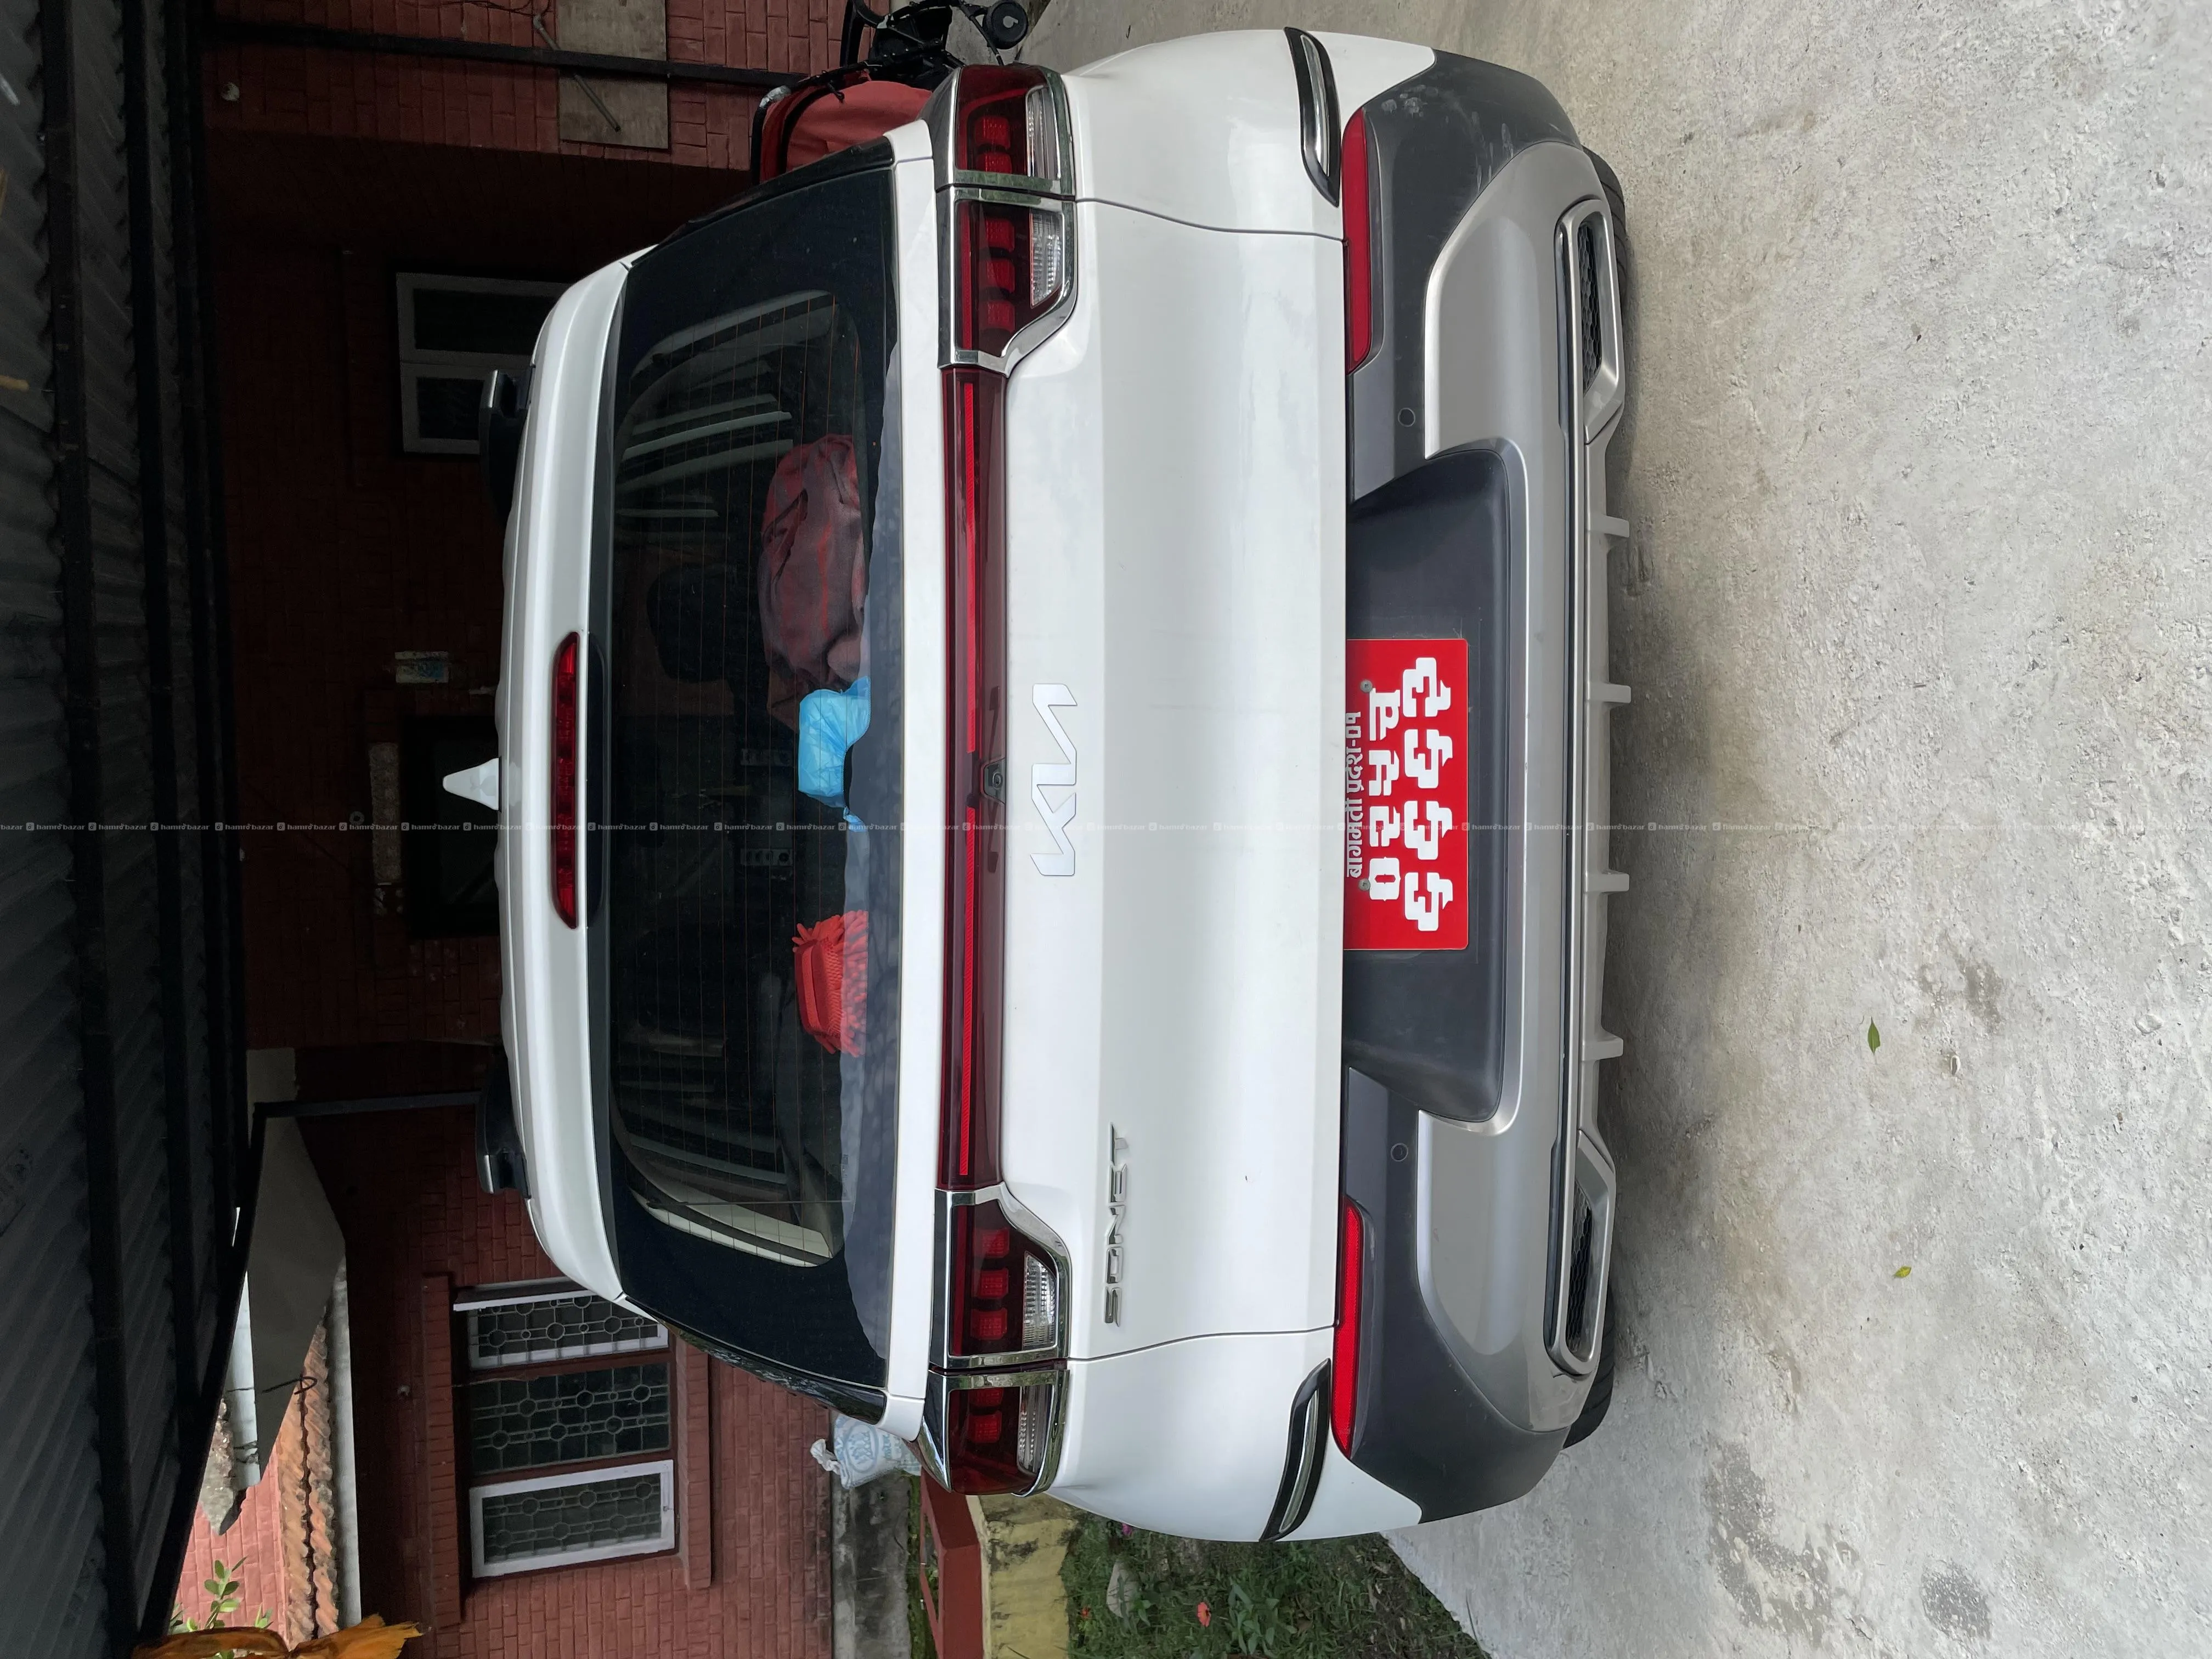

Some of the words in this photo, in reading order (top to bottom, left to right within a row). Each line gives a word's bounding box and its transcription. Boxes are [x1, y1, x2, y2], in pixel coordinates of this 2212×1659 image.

[1030, 684, 1077, 876] KIA
[1402, 657, 1453, 932] ६६६३
[1103, 1122, 1128, 1327] SONET
